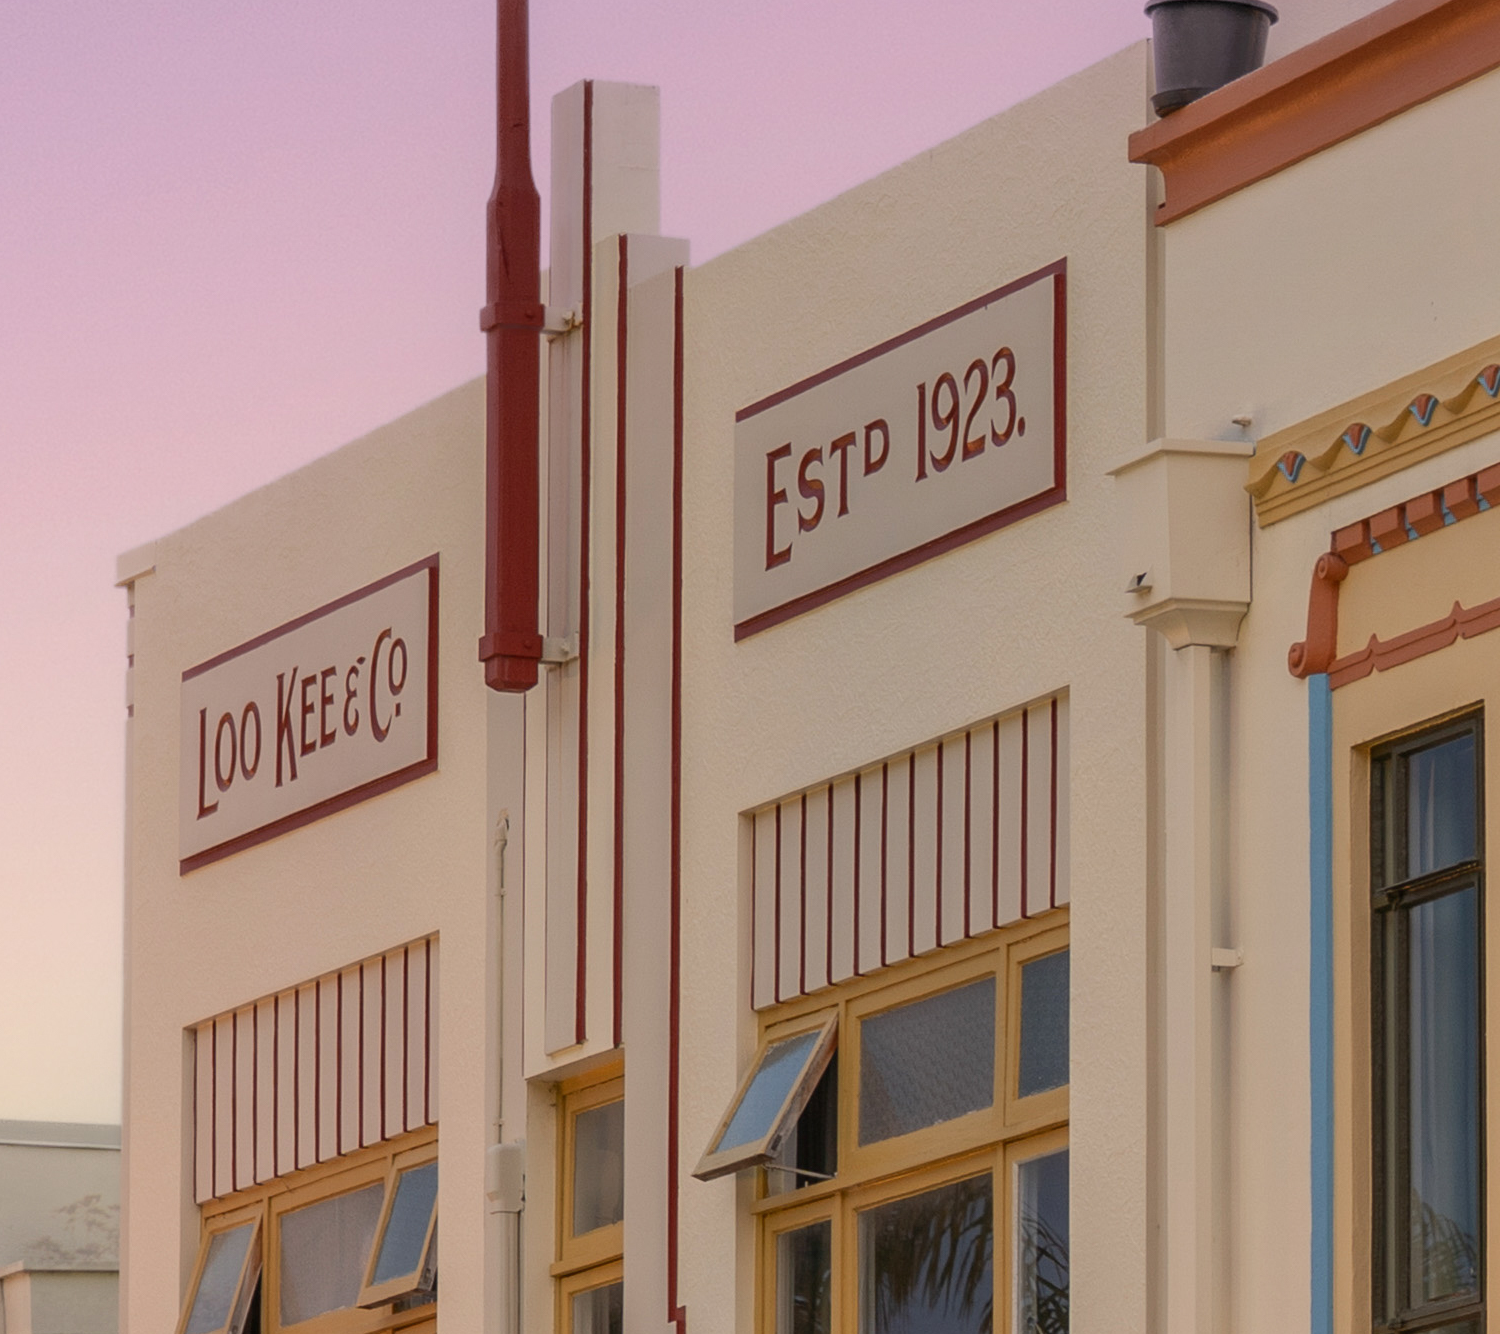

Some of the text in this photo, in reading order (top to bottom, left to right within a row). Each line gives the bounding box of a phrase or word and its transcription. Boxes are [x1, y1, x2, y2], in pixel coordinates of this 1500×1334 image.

[765, 418, 890, 571] ESTD
[197, 701, 261, 820] LOO
[275, 666, 337, 788] KEE
[343, 656, 366, 736] &
